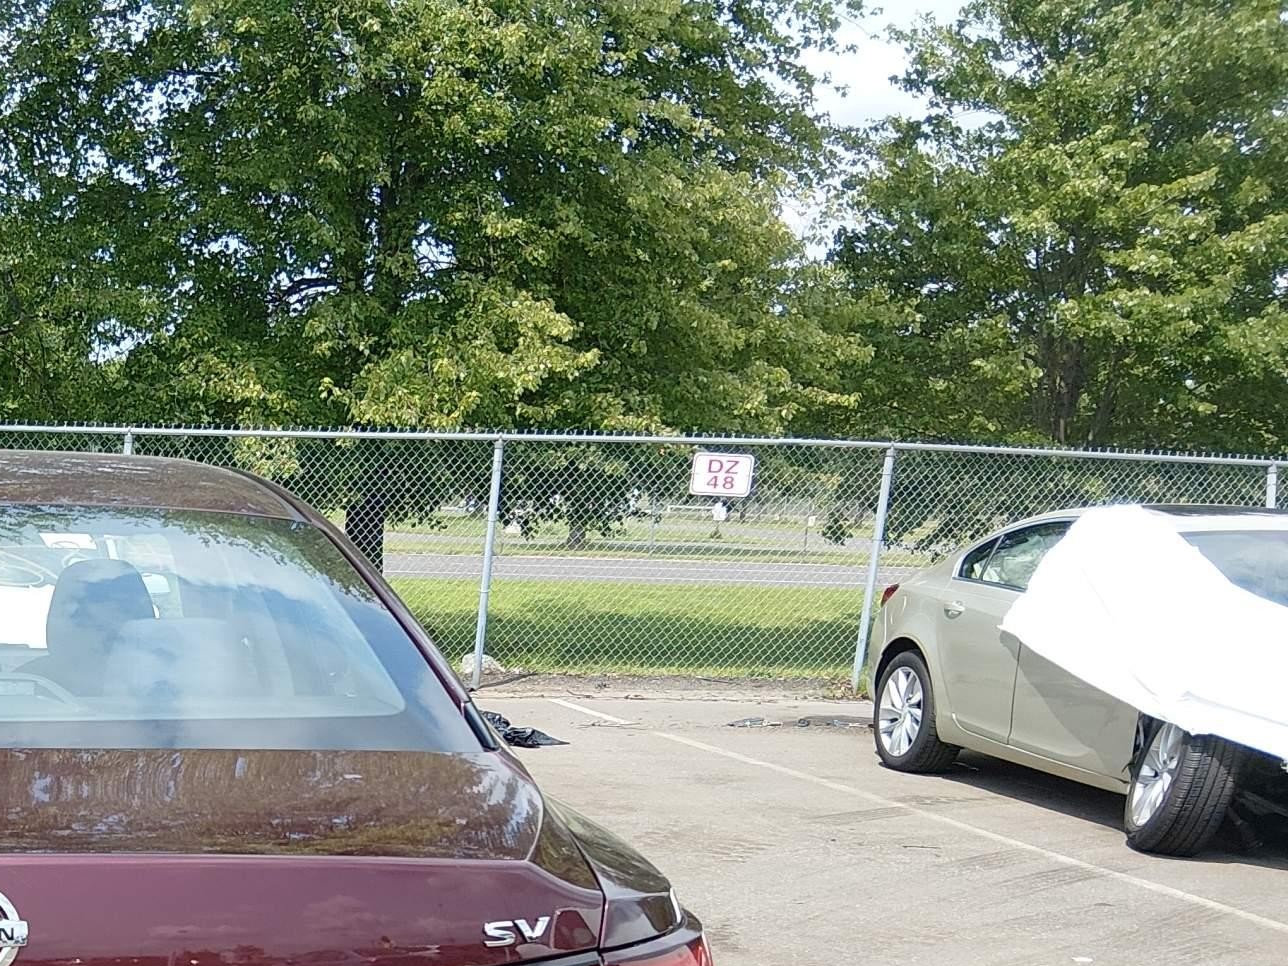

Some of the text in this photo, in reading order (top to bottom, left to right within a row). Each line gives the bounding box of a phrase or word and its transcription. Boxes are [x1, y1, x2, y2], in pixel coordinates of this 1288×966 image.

[707, 459, 740, 475] DZ
[706, 475, 735, 490] 48
[482, 915, 551, 948] SV
